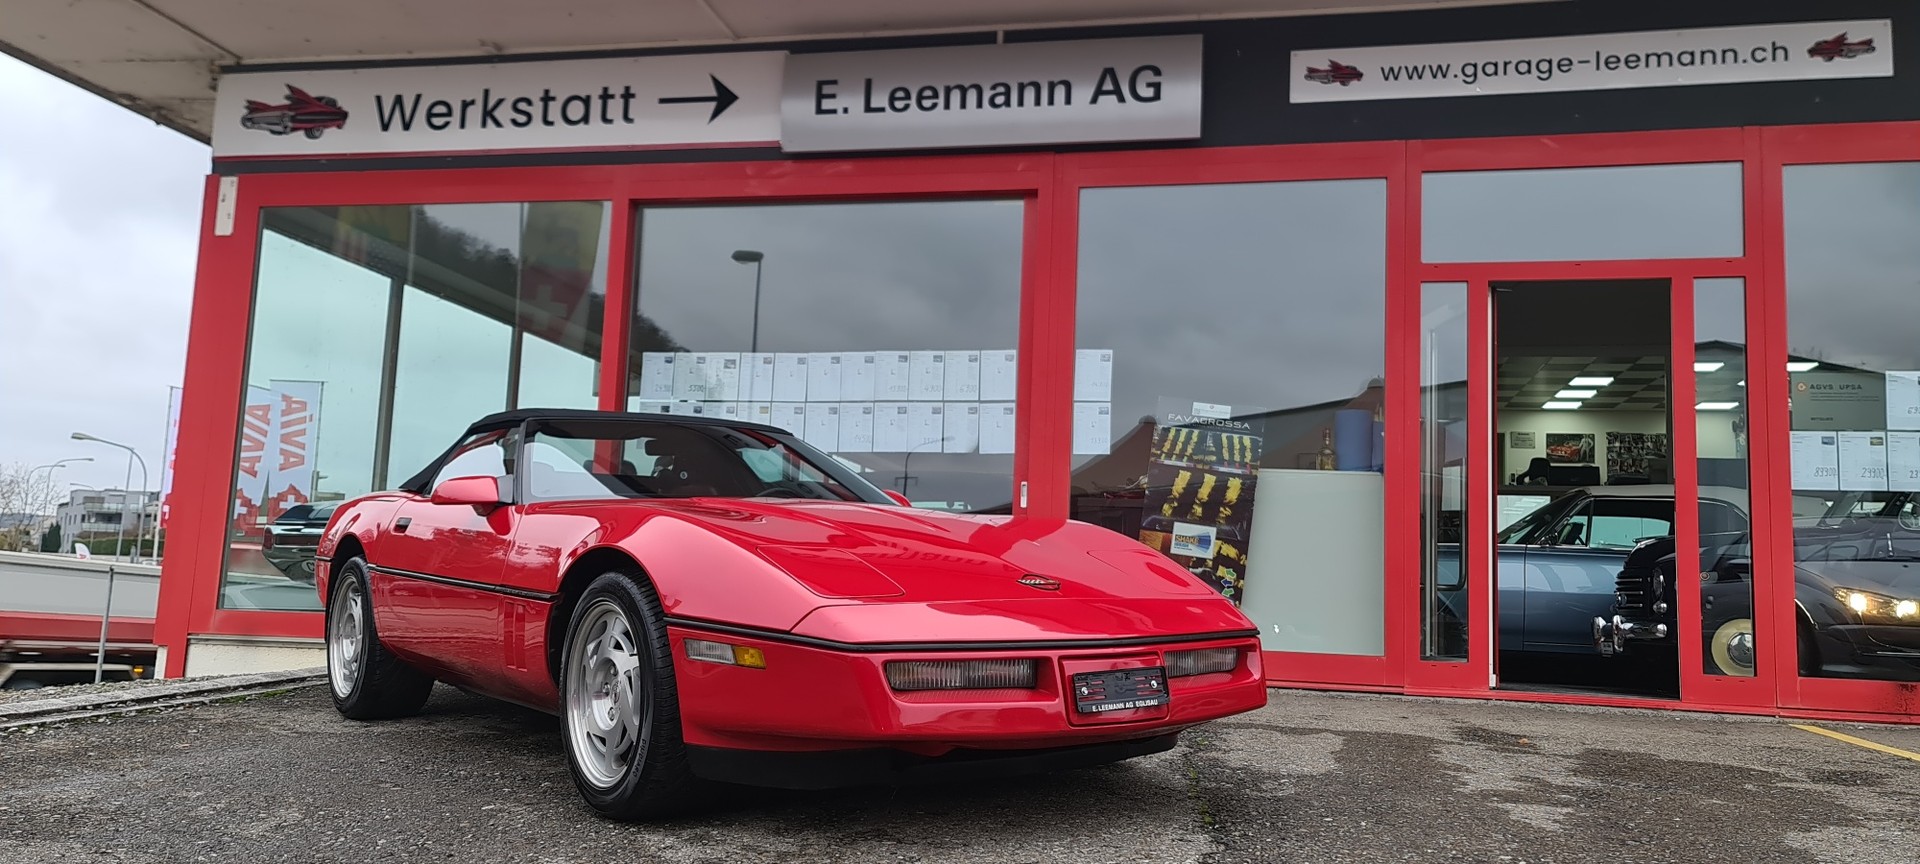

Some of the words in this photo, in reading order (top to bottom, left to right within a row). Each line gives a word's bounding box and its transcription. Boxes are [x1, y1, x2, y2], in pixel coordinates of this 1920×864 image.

[1381, 42, 1789, 85] www.garage-leemann.ch
[374, 85, 636, 133] Werkstatt
[814, 79, 850, 115] E.
[863, 77, 1073, 114] Leemann
[1089, 64, 1163, 106] AG
[1167, 413, 1251, 430] FAVAGROSSA
[1098, 702, 1125, 712] LEEMANN
[1125, 701, 1134, 709] AG
[1135, 699, 1159, 708] EGLISAU
